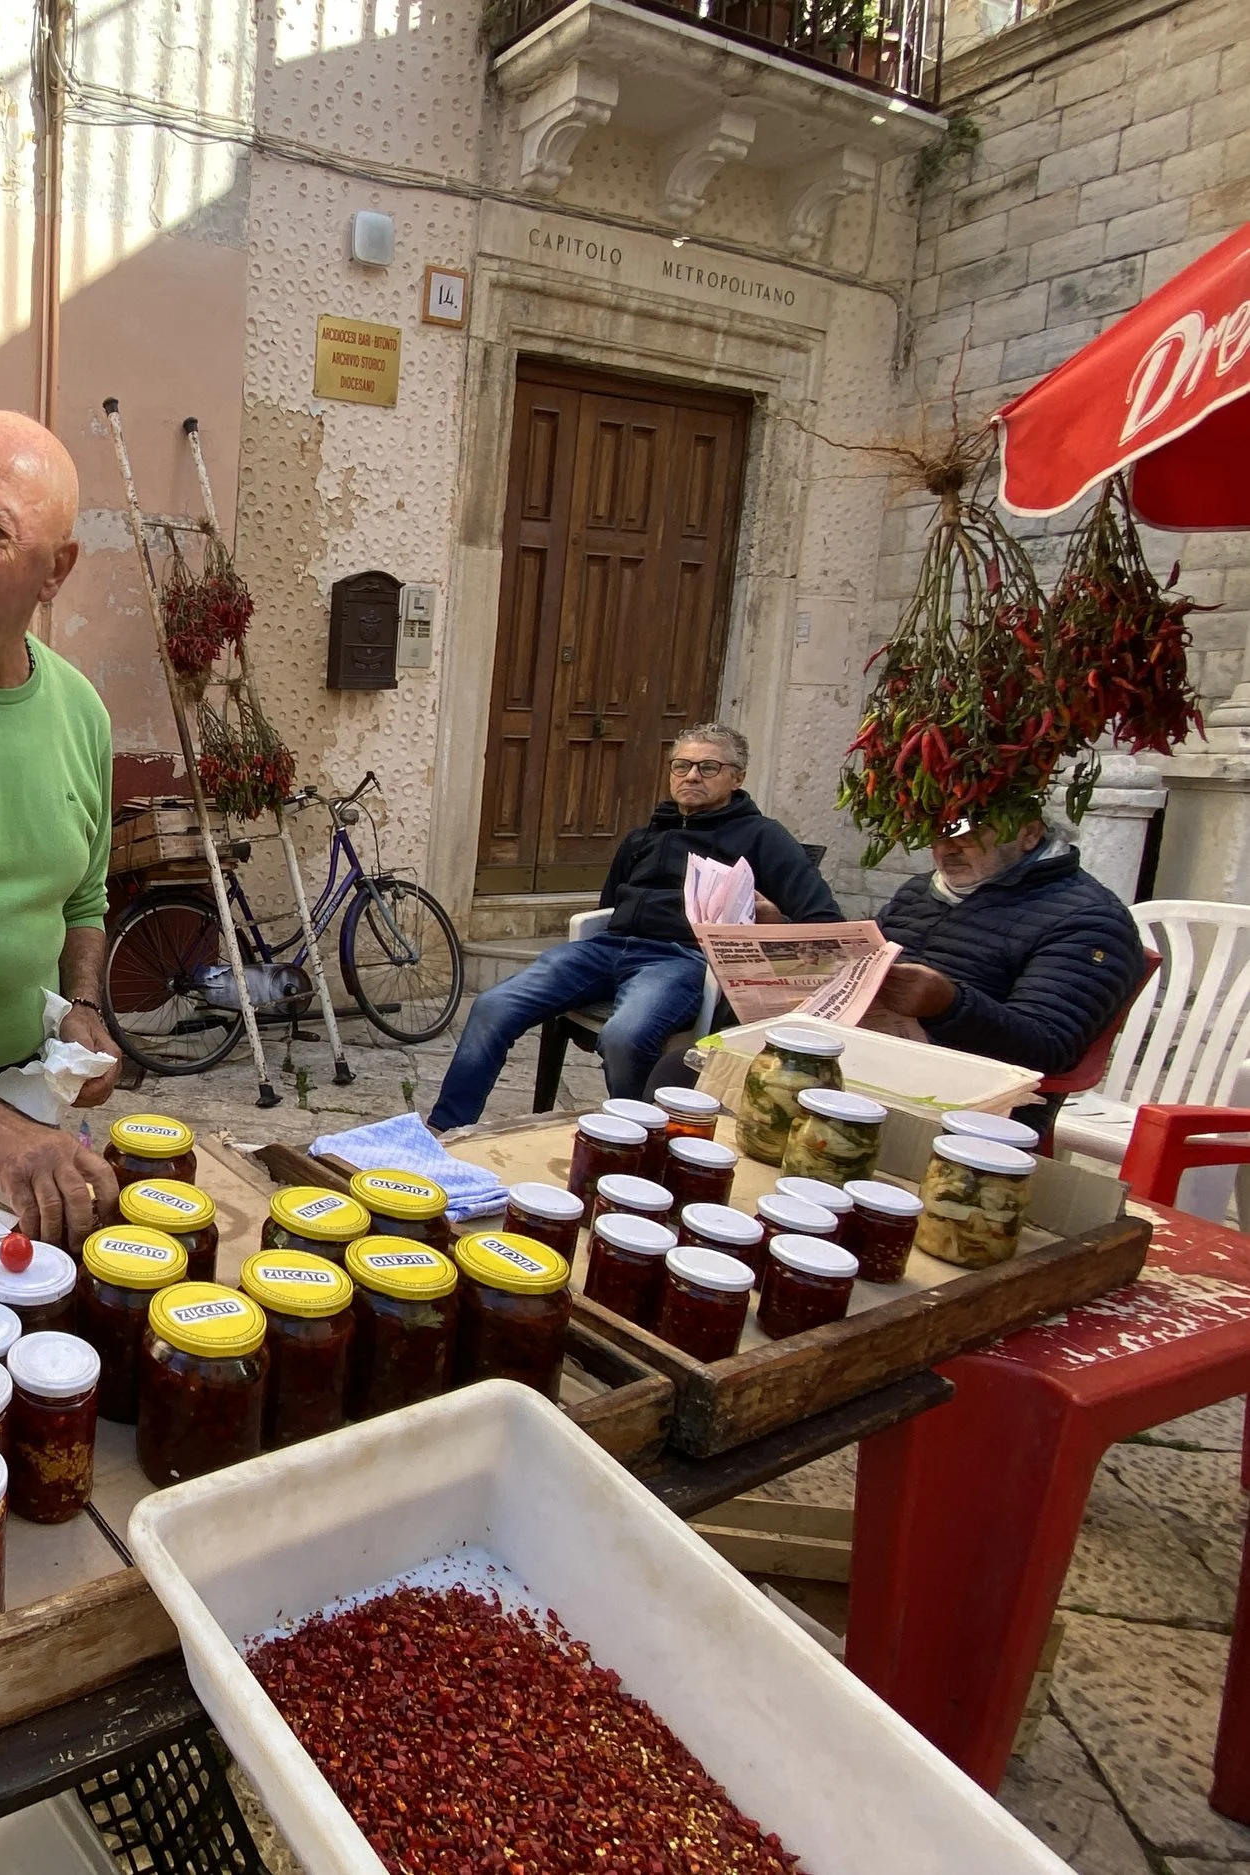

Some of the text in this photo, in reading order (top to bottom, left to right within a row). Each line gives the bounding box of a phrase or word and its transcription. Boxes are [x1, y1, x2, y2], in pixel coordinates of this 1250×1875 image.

[528, 227, 796, 306] CAPITOLO METROPOLITANO
[331, 351, 386, 372] ARCHIVIO STORICO
[340, 375, 376, 393] DIOCESANO
[126, 1124, 178, 1137] ZUCCATO
[371, 1179, 430, 1197] ZUCCATO
[141, 1187, 194, 1212] ZUCCATO
[299, 1197, 342, 1218] ZUCCATO
[105, 1240, 167, 1260] ZUCCATO
[483, 1239, 541, 1272] ZUCCATO
[371, 1254, 433, 1267] ZUCCATO
[265, 1268, 330, 1283] ZUCCATO
[176, 1301, 239, 1322] ZUCCATO
